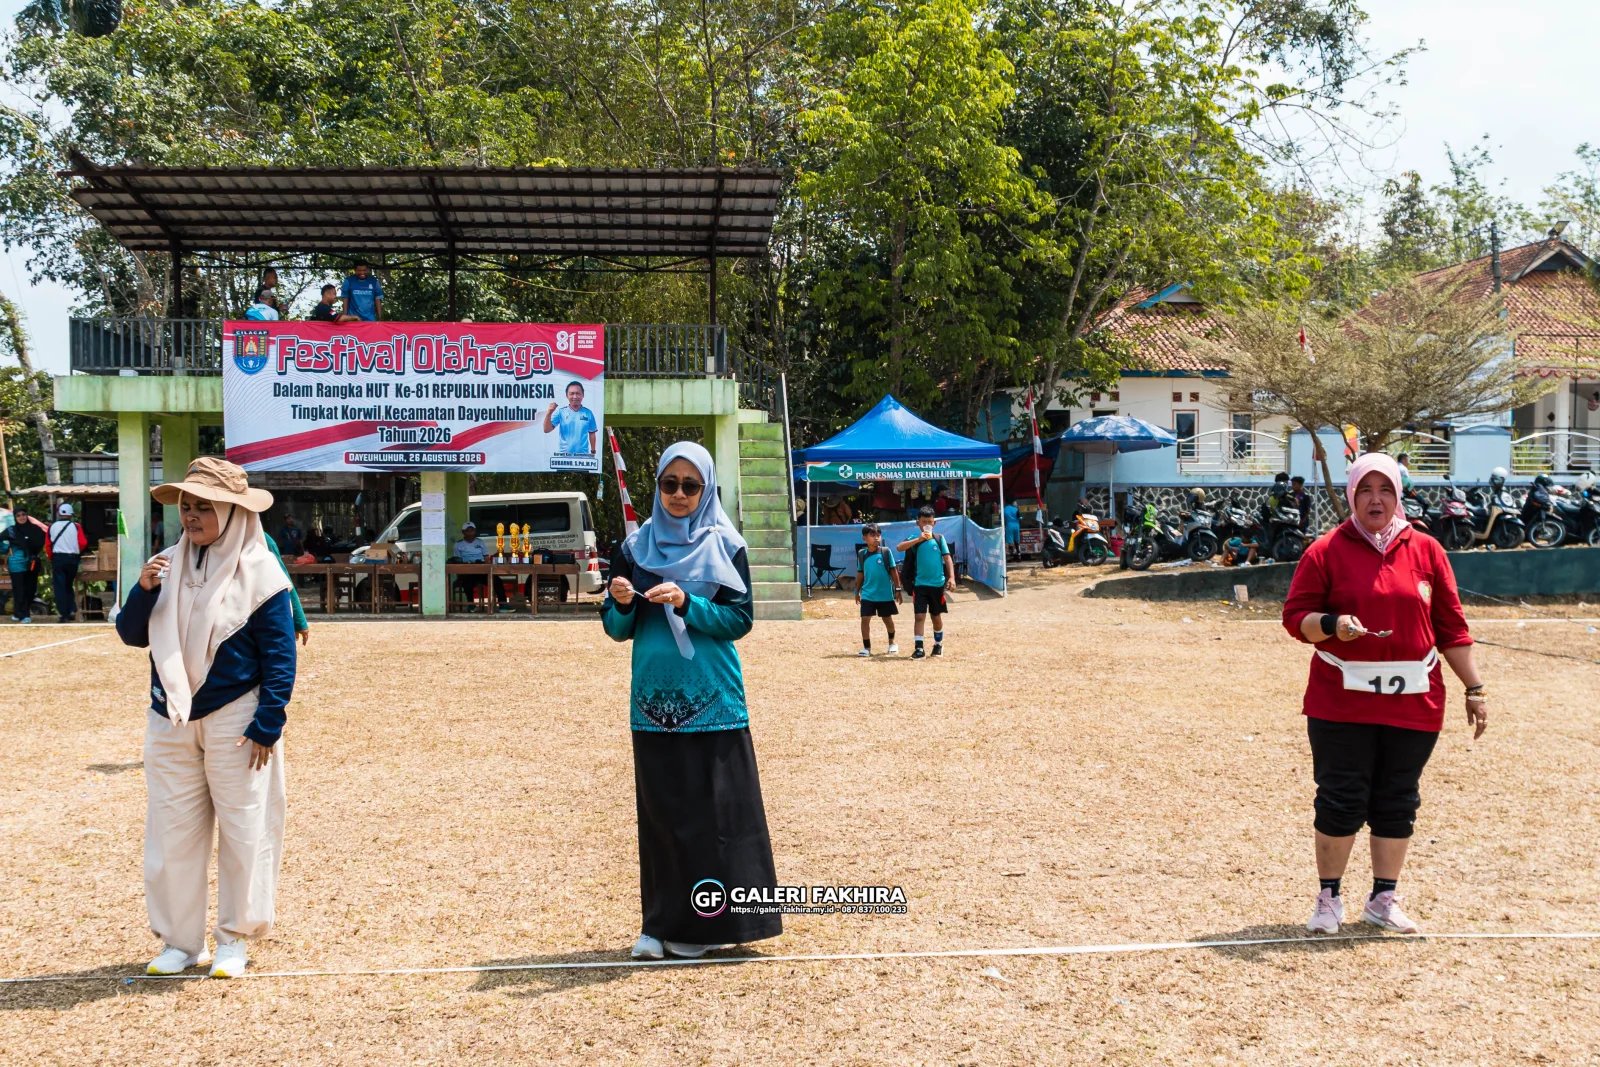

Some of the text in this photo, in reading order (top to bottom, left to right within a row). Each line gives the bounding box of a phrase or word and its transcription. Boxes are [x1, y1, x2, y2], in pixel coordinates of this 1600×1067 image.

[556, 331, 576, 354] 81
[277, 335, 553, 378] Festival Olahraga
[273, 382, 555, 400] Dalam Rangka HUT Ke-81 REPUBLIK INDONESIA
[291, 405, 537, 422] Tingkat Korwil Kecamatan Dayeuhluhur
[378, 427, 451, 443] Tahun 2026
[348, 453, 482, 464] DAYEUHLUHUR, 26 AGUSTUS 2026
[875, 461, 951, 470] POSKO KESEHATAN
[855, 471, 904, 480] PUSKESMAS
[905, 471, 963, 479] DAYEUHLUHUR
[1368, 675, 1406, 694] 12
